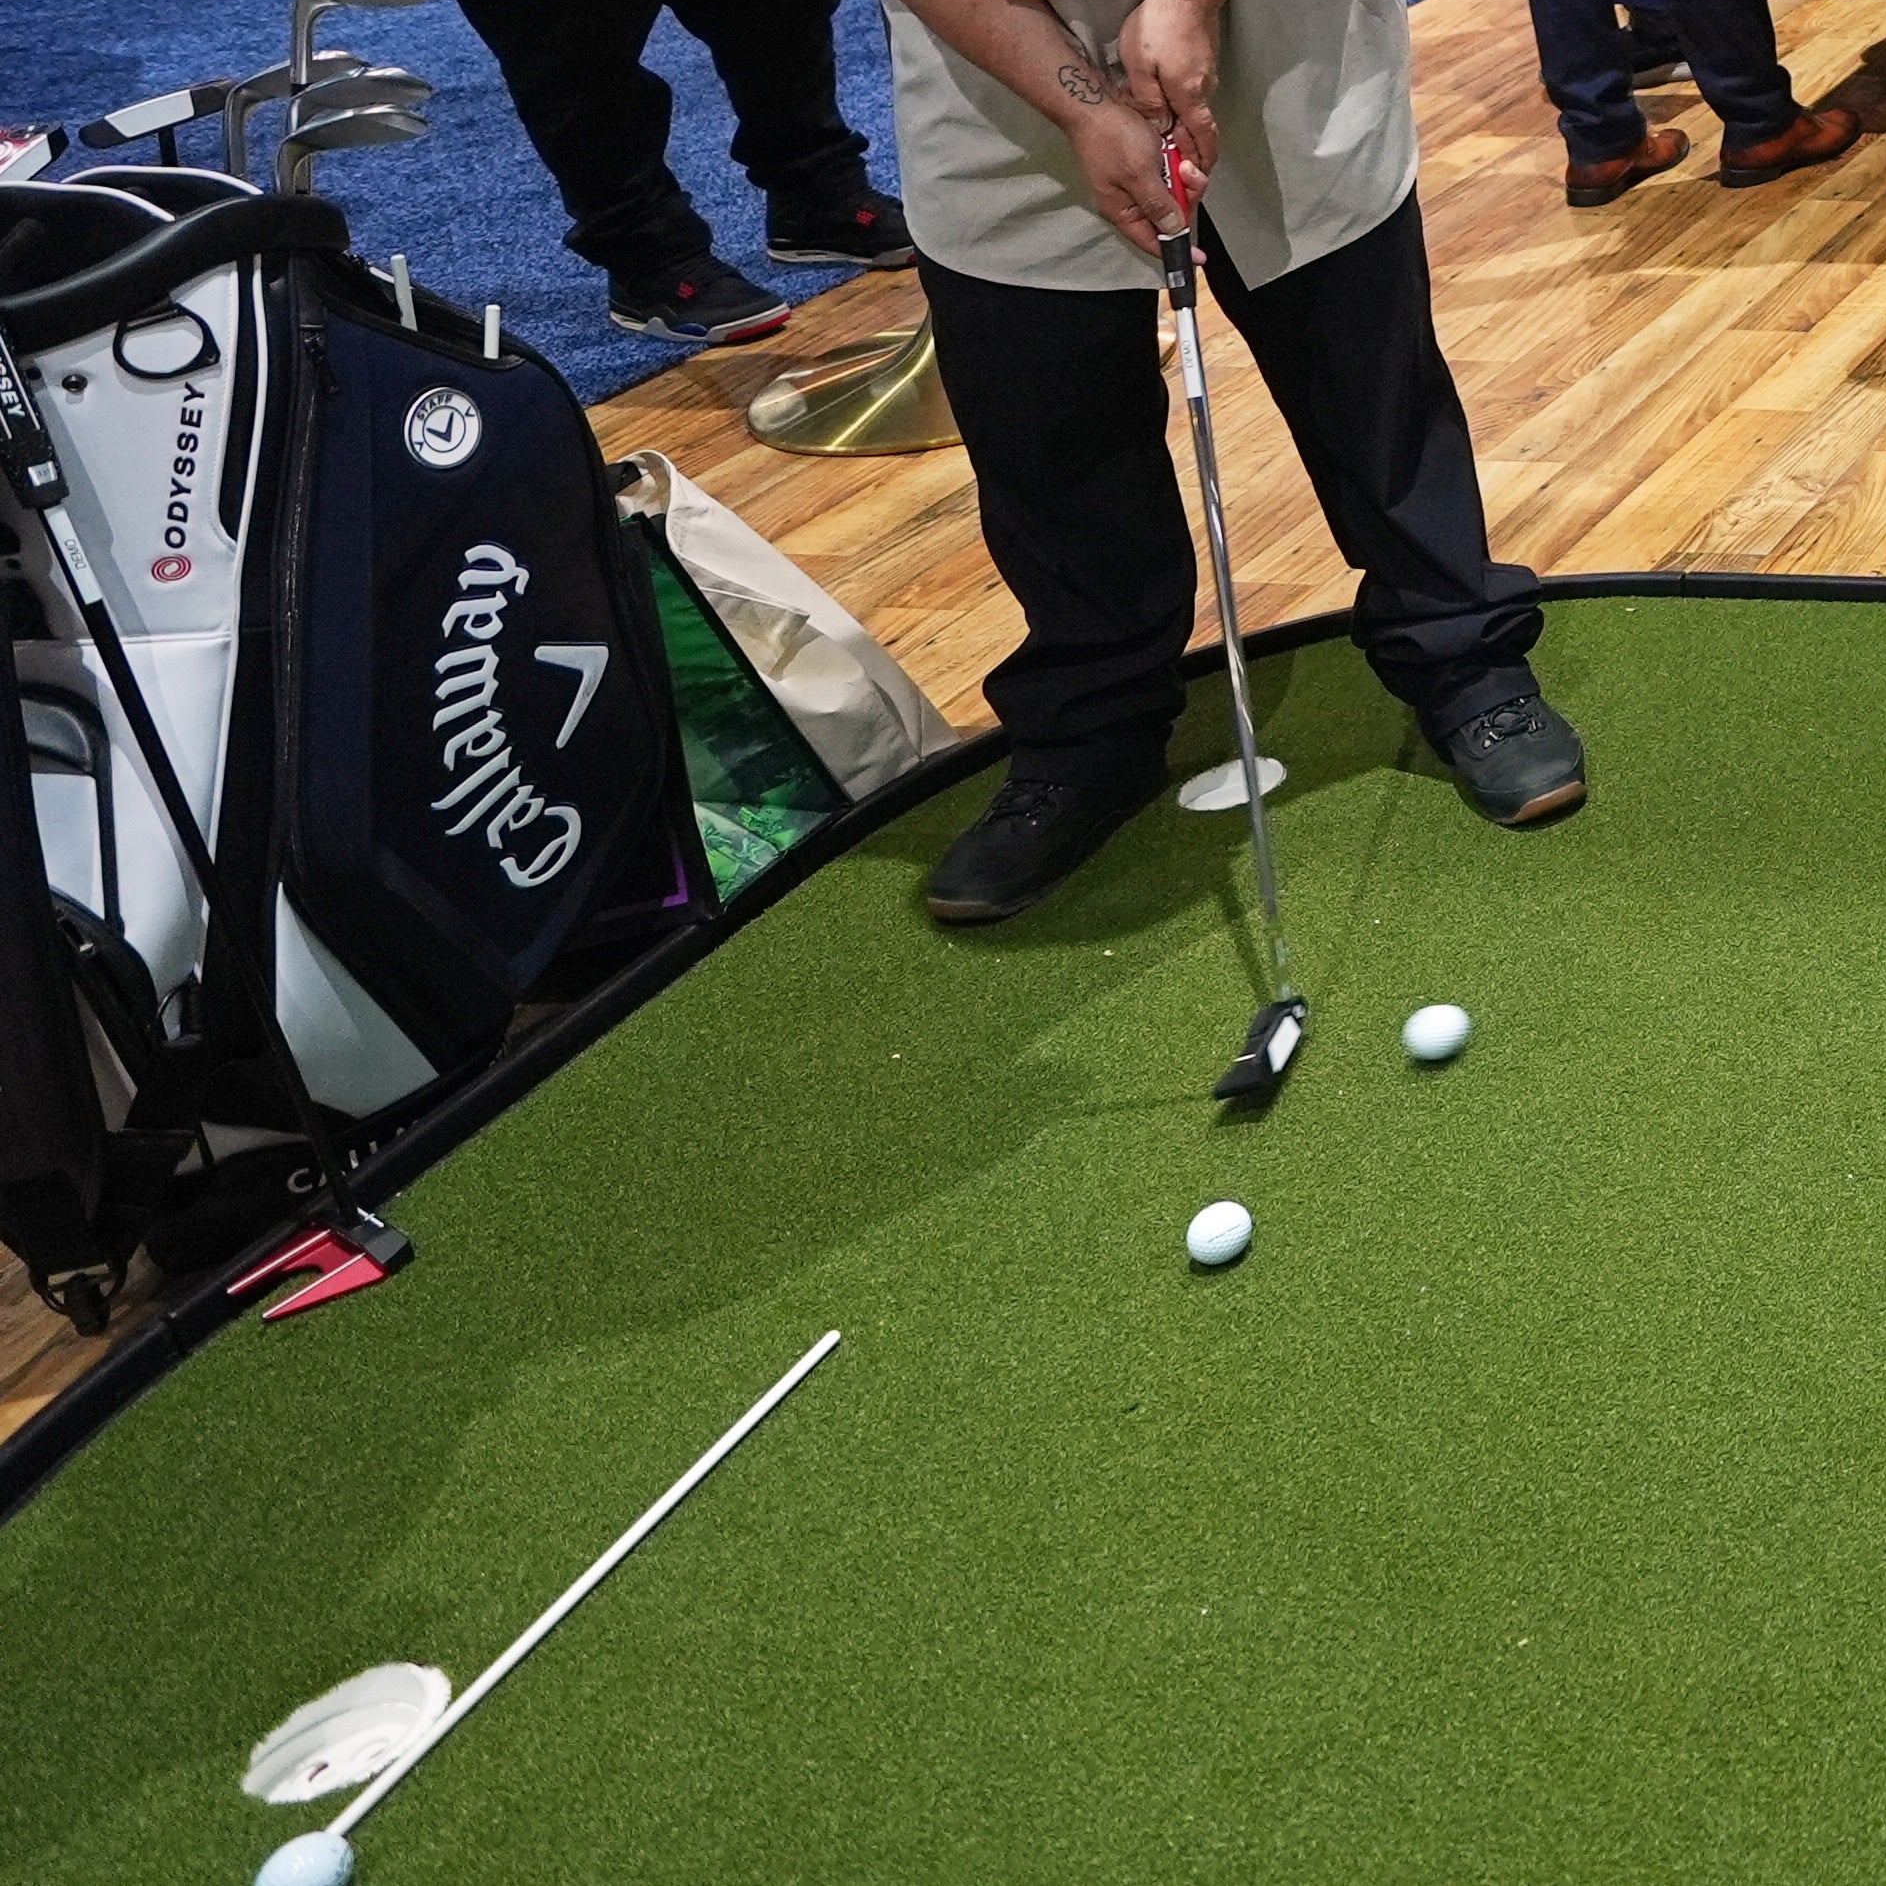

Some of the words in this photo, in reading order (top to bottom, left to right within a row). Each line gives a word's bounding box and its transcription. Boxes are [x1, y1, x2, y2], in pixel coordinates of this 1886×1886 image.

[416, 393, 454, 421] STAFF
[163, 381, 206, 550] ODYSSEY
[63, 537, 86, 571] DEMO
[431, 542, 583, 889] Callaway
